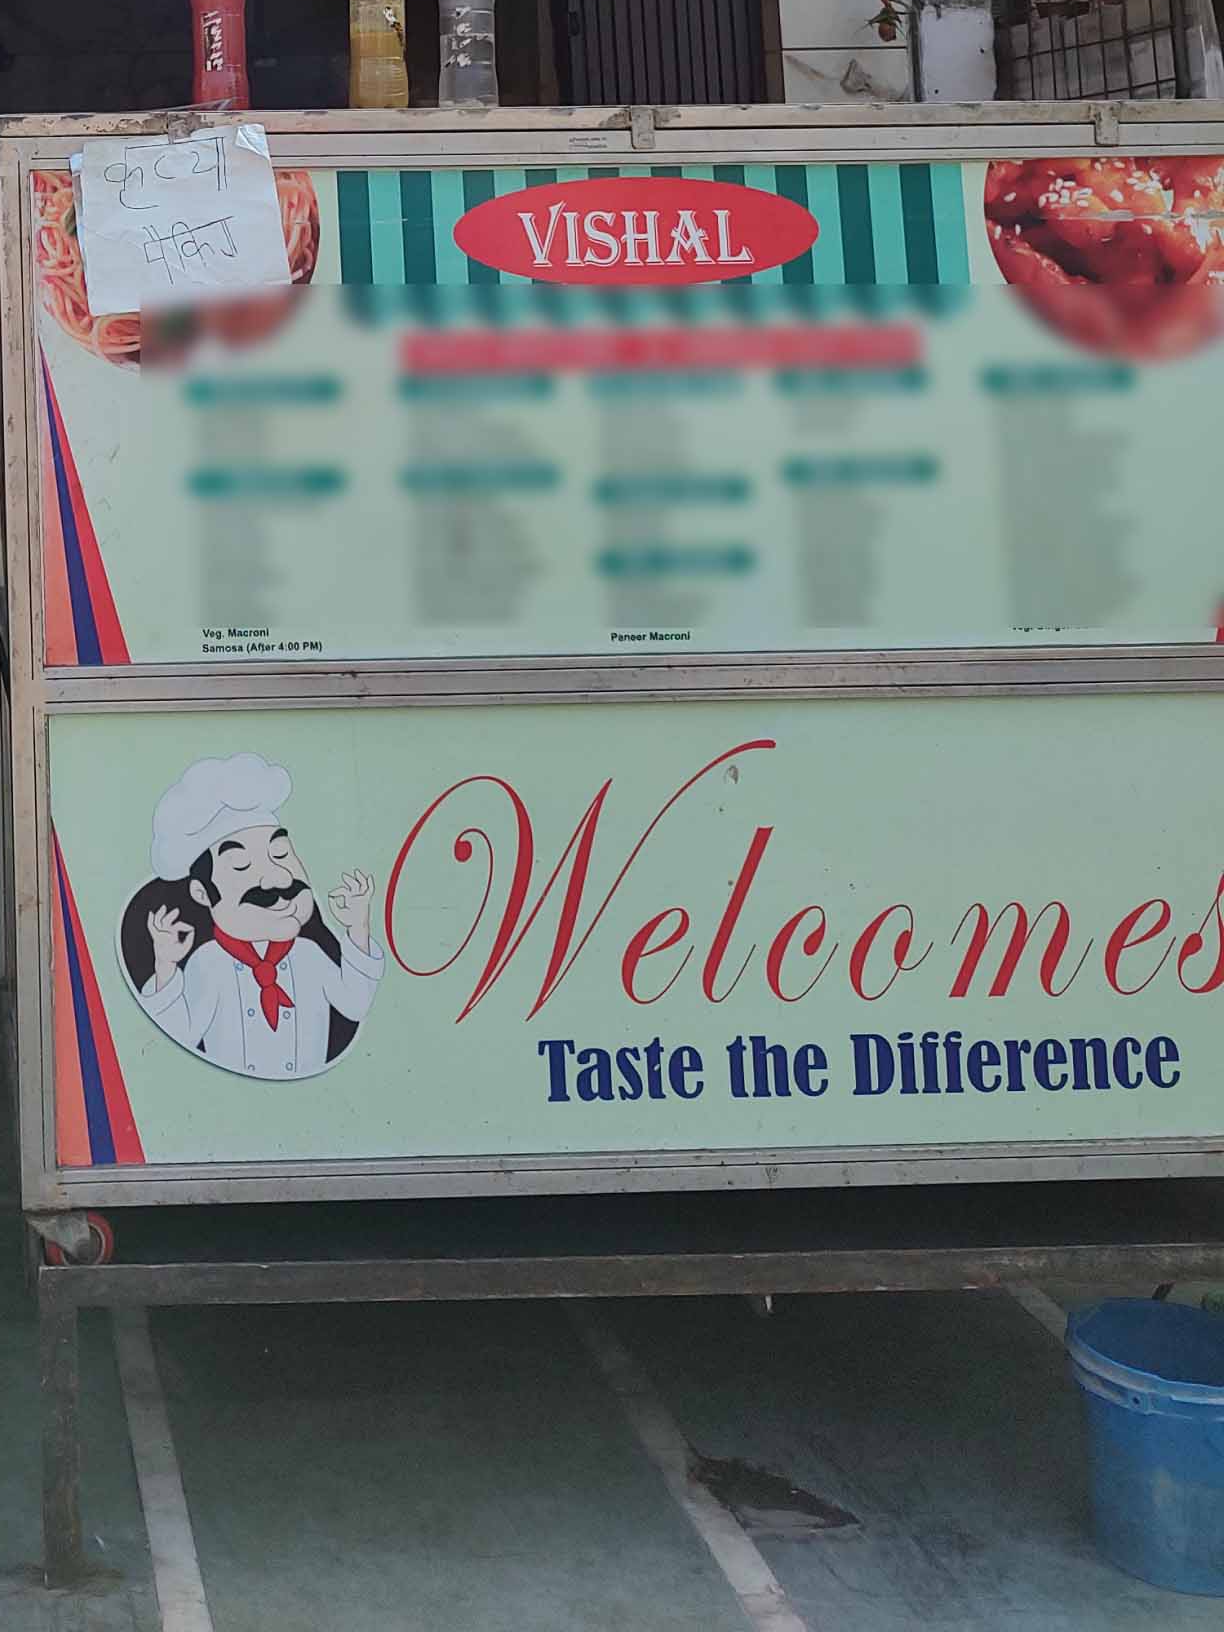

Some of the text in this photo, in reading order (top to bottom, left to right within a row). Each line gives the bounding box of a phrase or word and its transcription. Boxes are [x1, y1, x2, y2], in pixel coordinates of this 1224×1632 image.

[517, 200, 754, 270] VISHAL
[227, 627, 270, 638] Macroni
[610, 631, 690, 642] Paneer Macroni
[201, 643, 244, 653] Samosa
[247, 643, 276, 654] (After
[303, 642, 322, 652] PM)
[538, 1031, 1181, 1102] Taste the Difference
